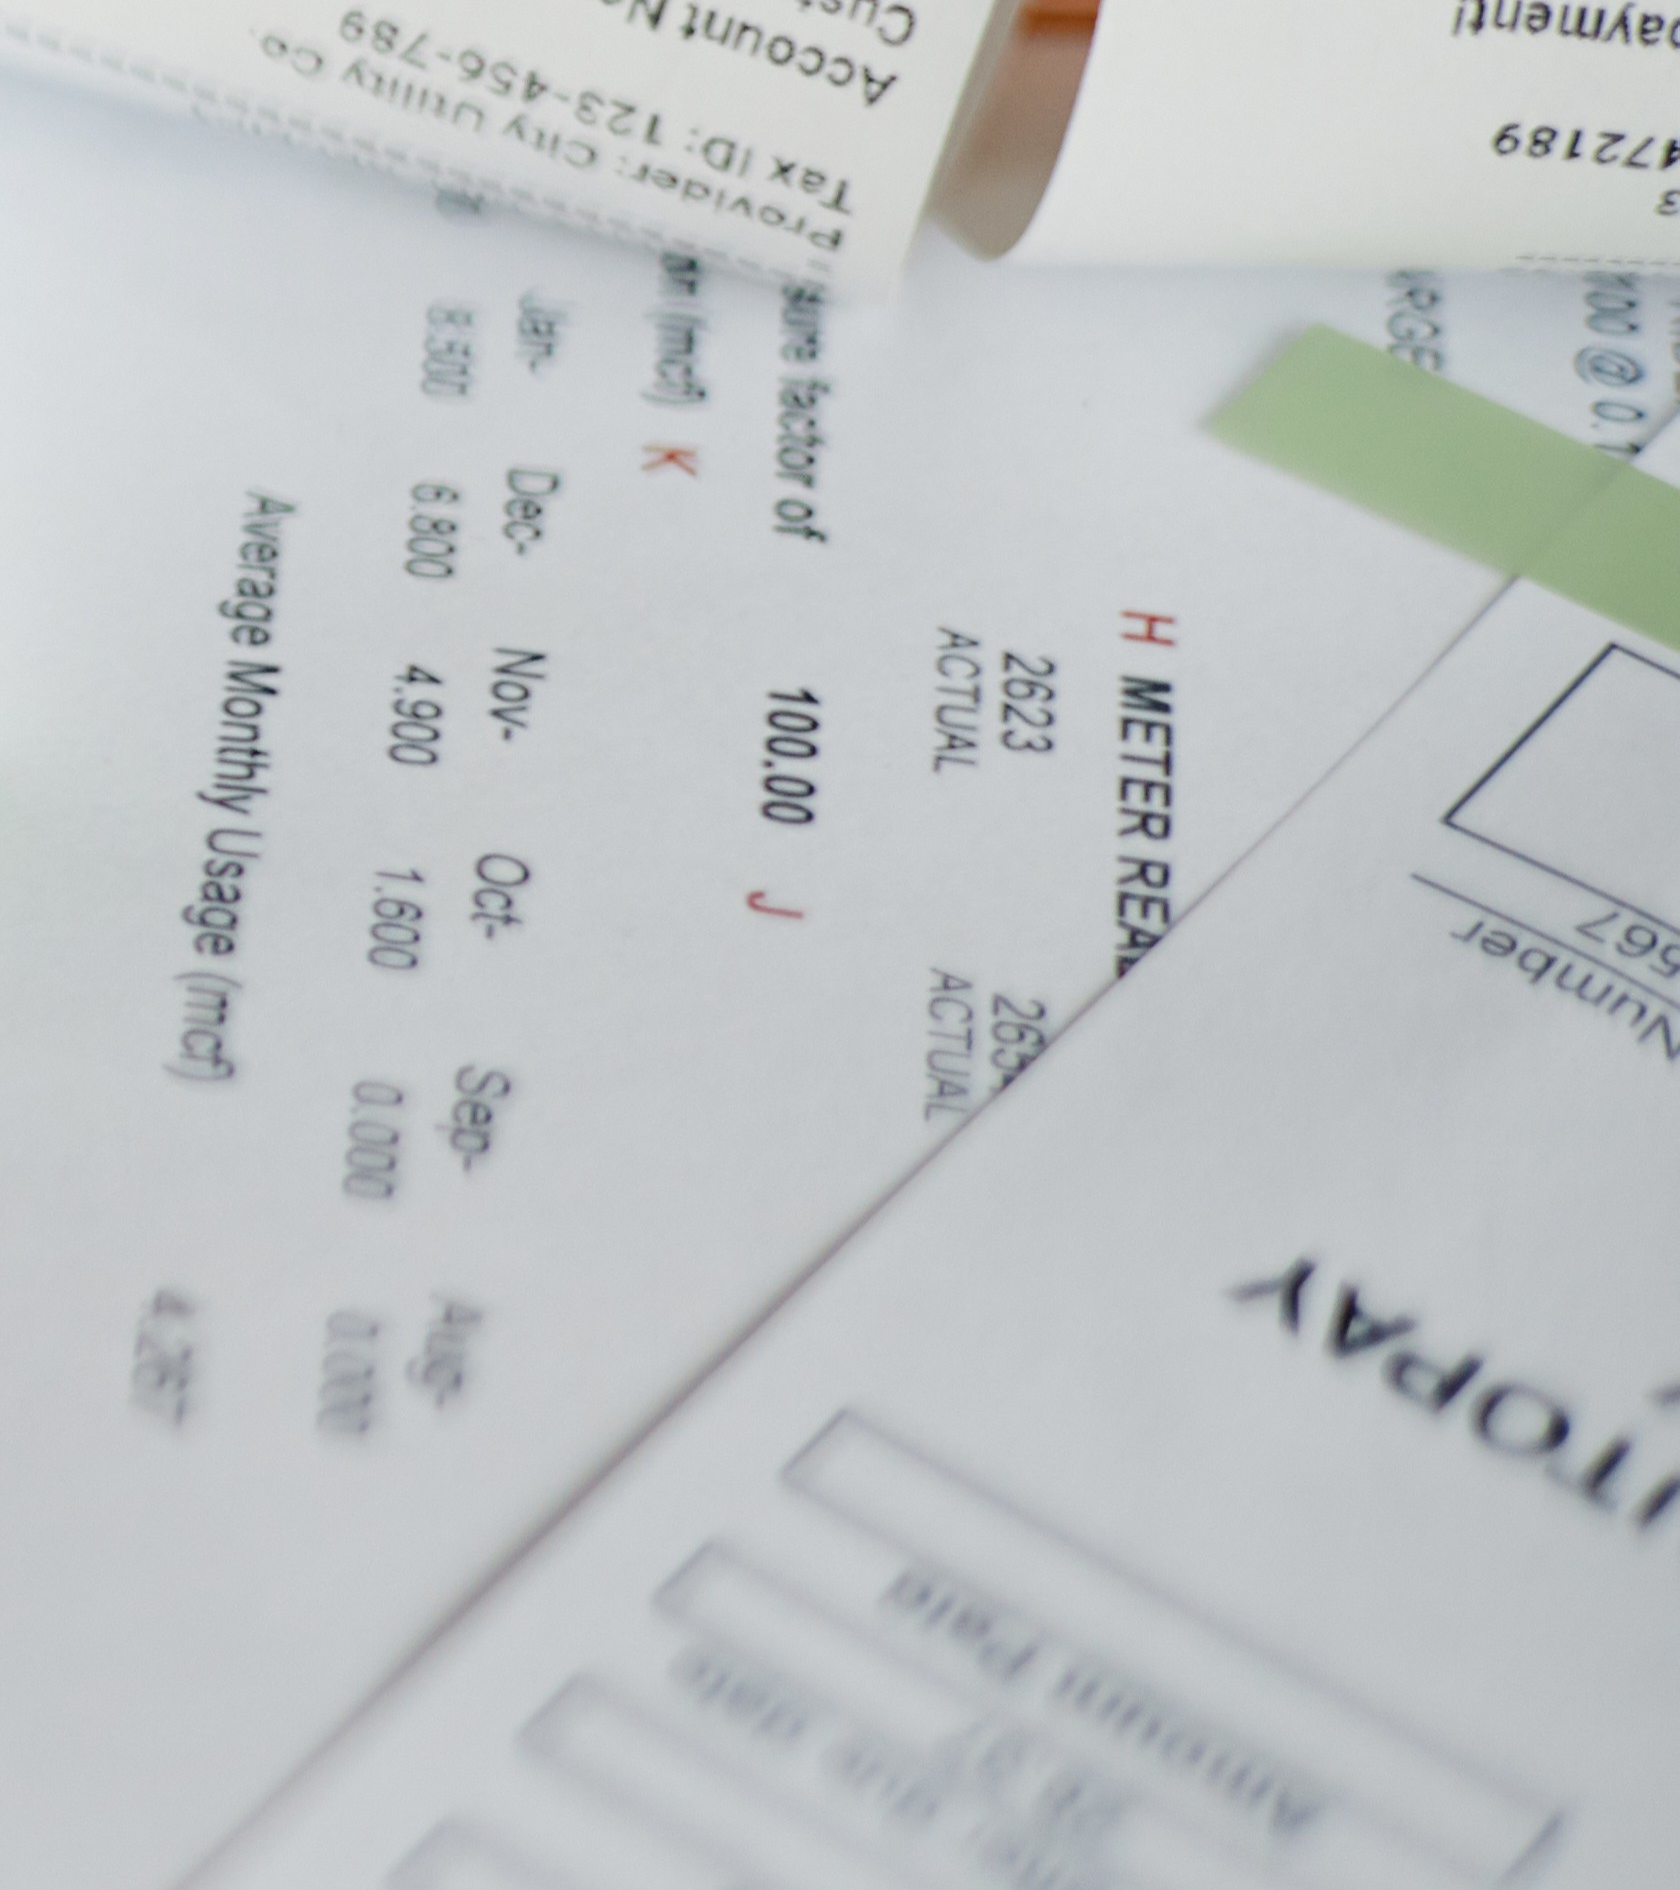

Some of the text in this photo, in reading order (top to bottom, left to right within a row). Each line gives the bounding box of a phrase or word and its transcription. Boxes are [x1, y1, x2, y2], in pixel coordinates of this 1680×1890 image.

[338, 7, 856, 214] Tax ID: 123-456-789
[681, 3, 901, 109] Account
[340, 60, 846, 253] Provider: City Utility
[640, 442, 700, 479] K
[771, 496, 829, 547] of
[486, 645, 550, 743] Nov-
[931, 624, 983, 775] ACTUAL
[1119, 608, 1179, 650] H
[180, 485, 300, 963] Average Monthly Usage
[759, 686, 822, 829] 100.00
[999, 650, 1056, 756] 2623
[1116, 672, 1174, 844] METER
[340, 481, 461, 1203] 6.800 4.900 1.600 0.000
[469, 850, 533, 942] Oct-
[922, 964, 975, 1124] ACTUAL
